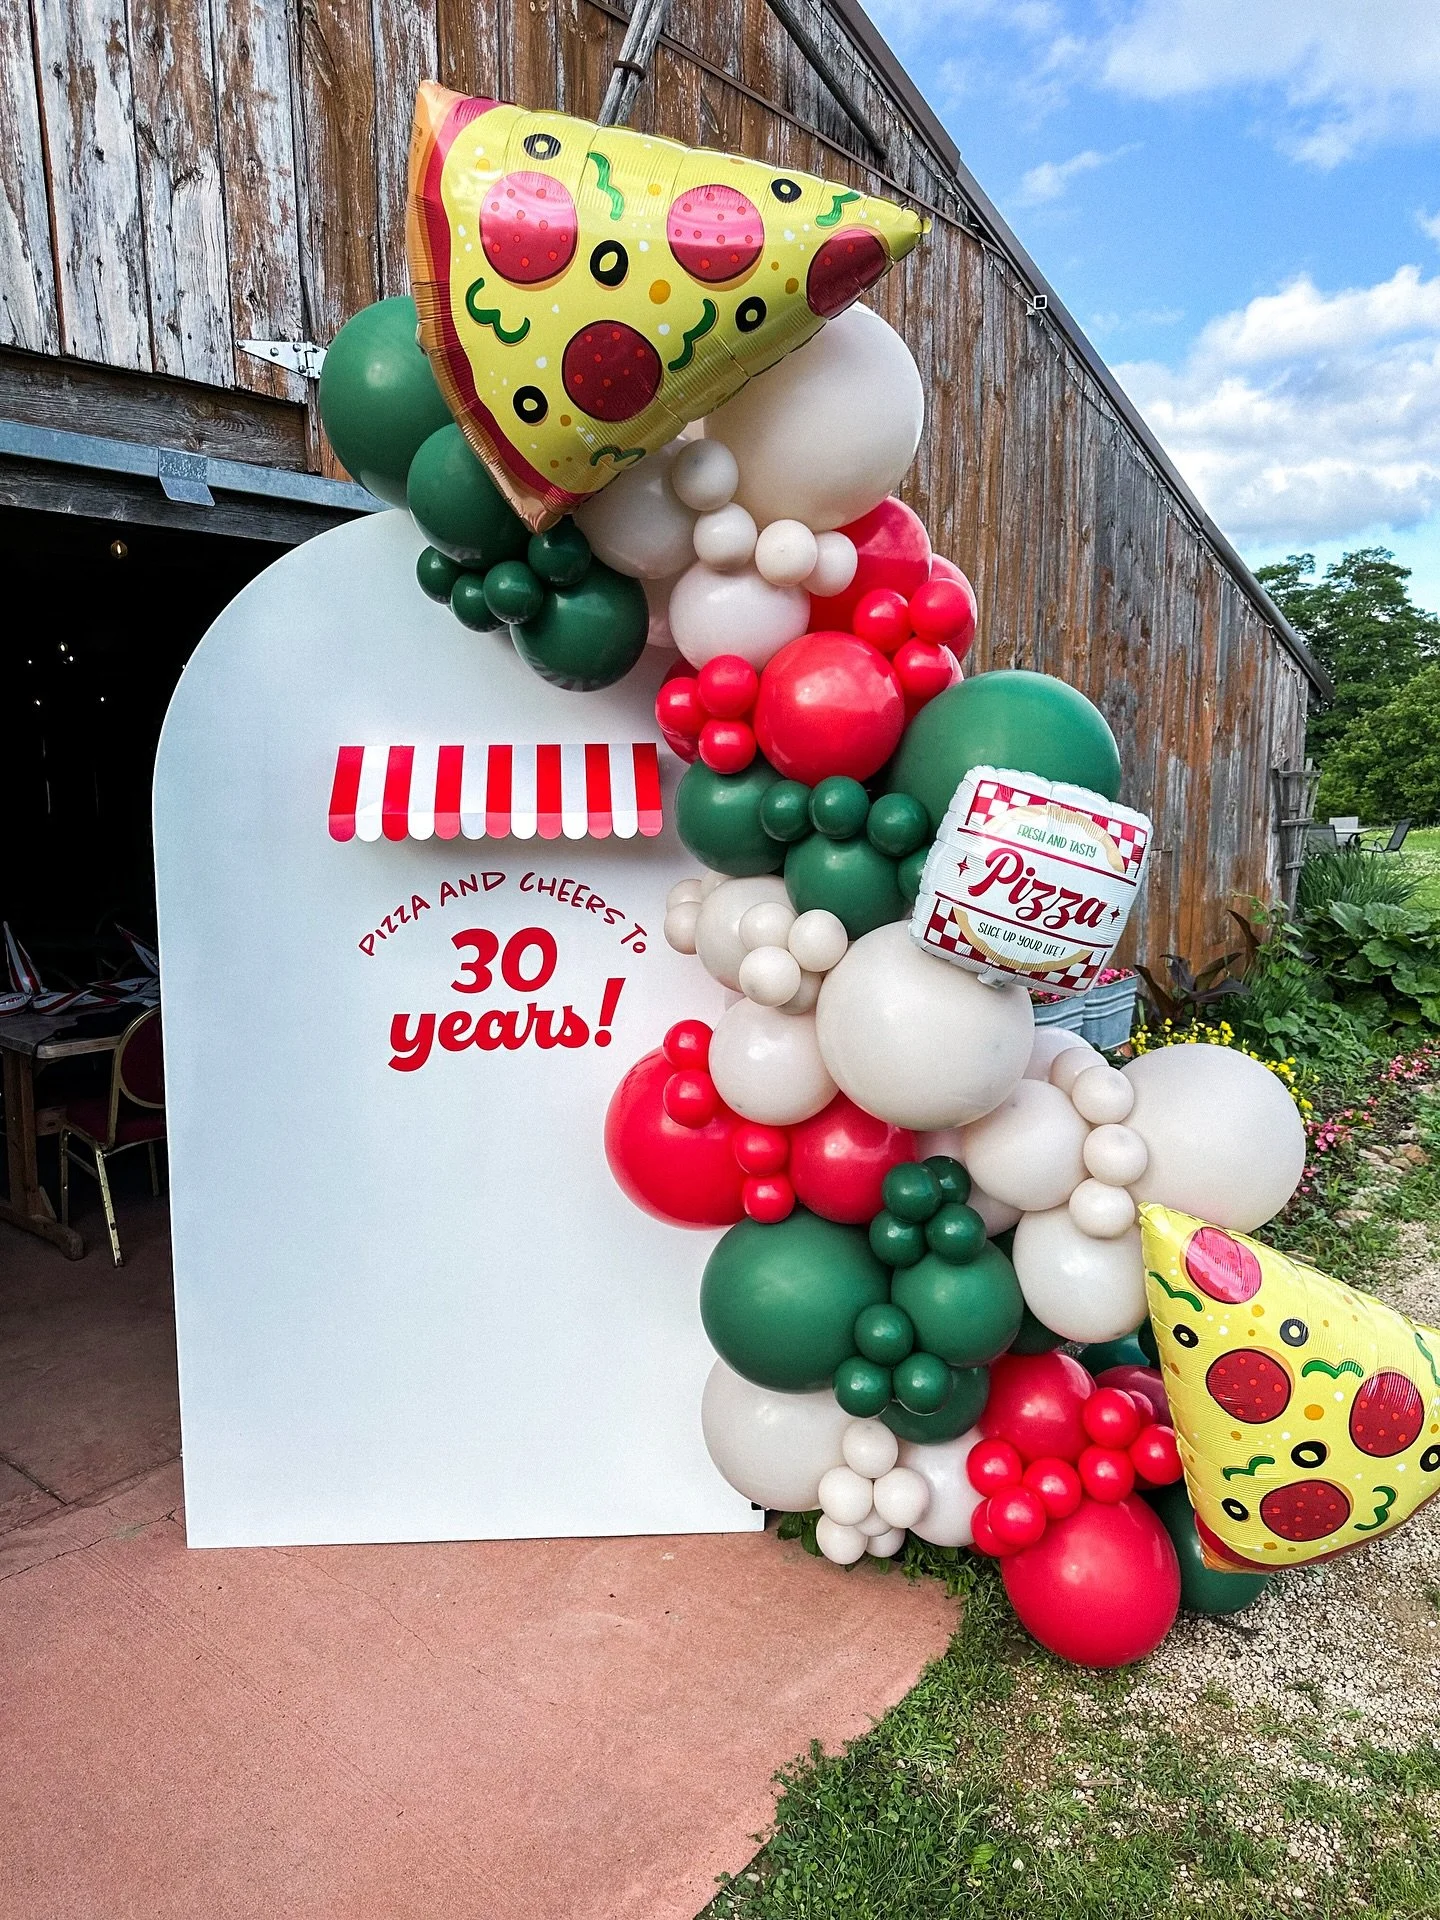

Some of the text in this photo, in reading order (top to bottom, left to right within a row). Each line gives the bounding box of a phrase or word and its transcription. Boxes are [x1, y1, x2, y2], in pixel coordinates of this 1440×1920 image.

[1017, 824, 1097, 858] FRESH AND TASTY
[358, 895, 430, 956] PIZZA
[440, 871, 506, 907] AND
[519, 871, 626, 925] CHEERS
[967, 847, 1108, 930] Pizza
[450, 926, 558, 994] 30
[977, 921, 1002, 939] SLICE
[1002, 929, 1016, 942] UP
[1016, 935, 1042, 952] YOUR
[388, 977, 627, 1072] years!
